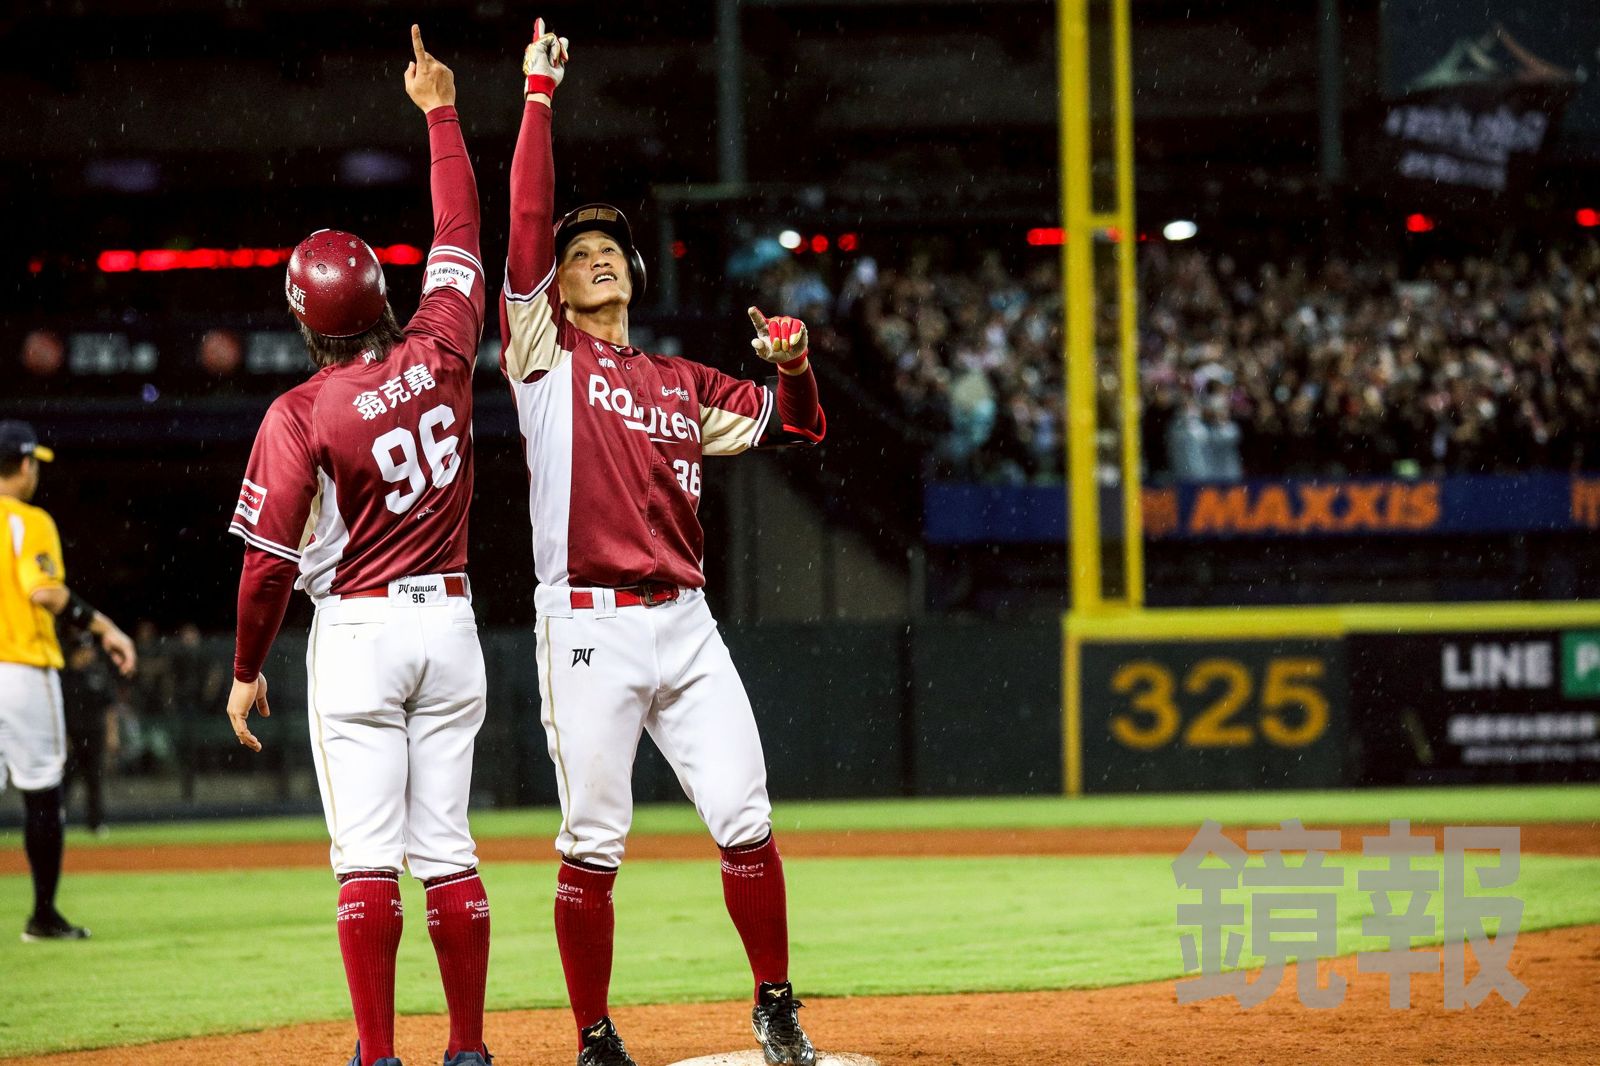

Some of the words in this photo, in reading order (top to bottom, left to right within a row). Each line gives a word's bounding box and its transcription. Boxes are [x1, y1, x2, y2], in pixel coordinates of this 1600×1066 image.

[353, 363, 437, 421] 翁克堯
[371, 404, 462, 515] 96
[673, 459, 701, 498] 36
[1190, 482, 1442, 531] MAXXIS
[412, 593, 426, 604] 96
[1442, 640, 1553, 690] LINE
[1574, 639, 1600, 683] P
[1110, 659, 1330, 750] 325
